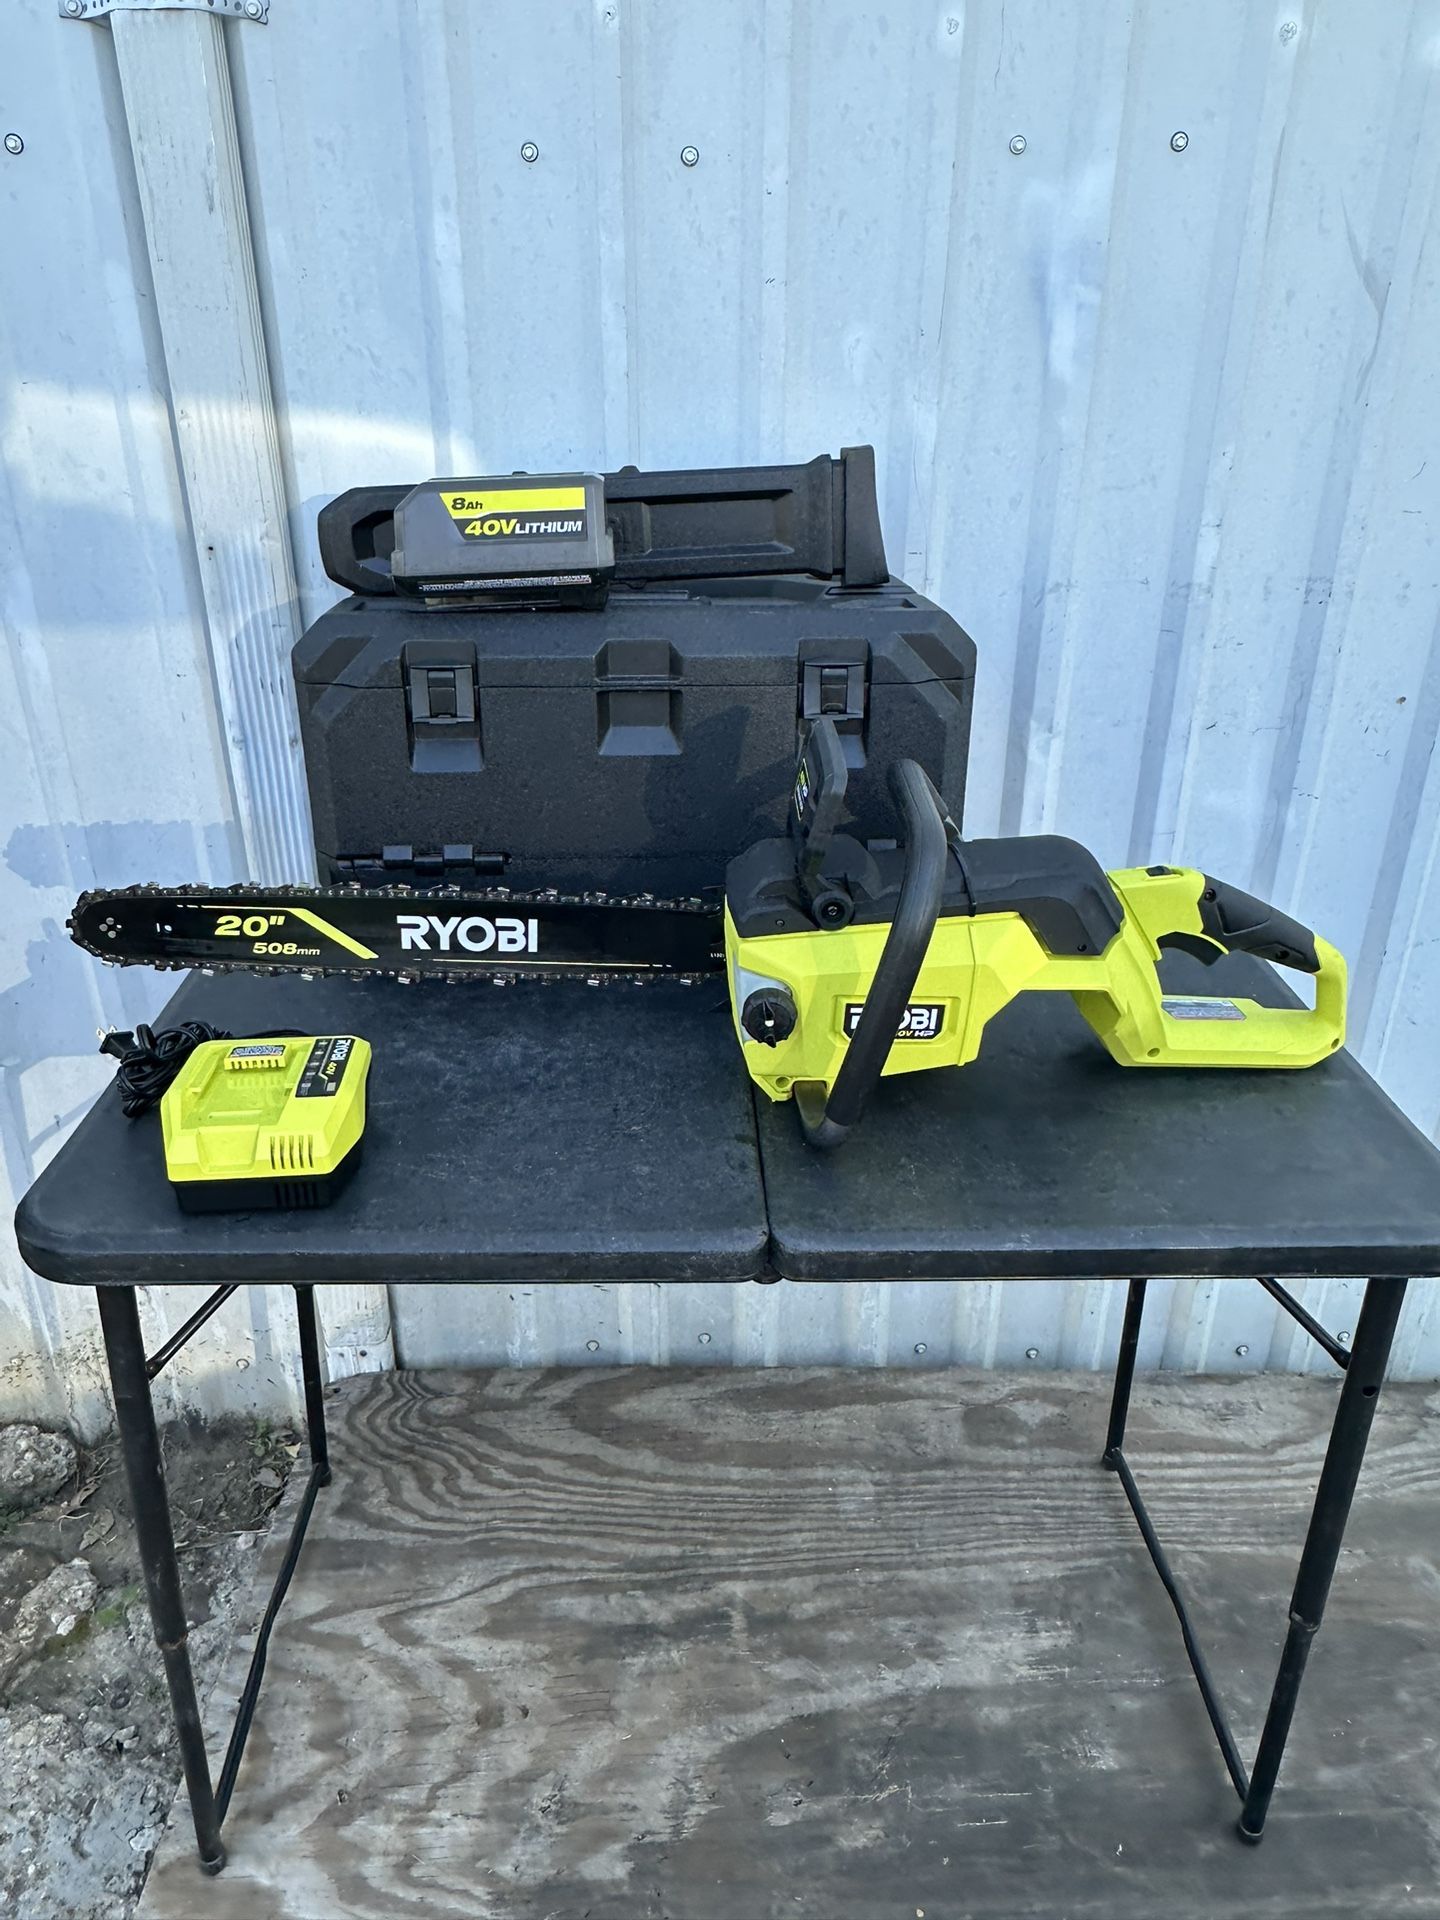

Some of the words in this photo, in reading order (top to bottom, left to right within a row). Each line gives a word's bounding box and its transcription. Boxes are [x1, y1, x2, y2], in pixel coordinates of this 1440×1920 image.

[451, 498, 483, 510] 8Ah
[464, 519, 517, 536] 40V
[515, 521, 582, 534] LITHIUM
[214, 915, 285, 937] 20"
[396, 915, 538, 953] RYOBI
[252, 942, 320, 956] 508mm
[850, 1007, 938, 1030] RBI
